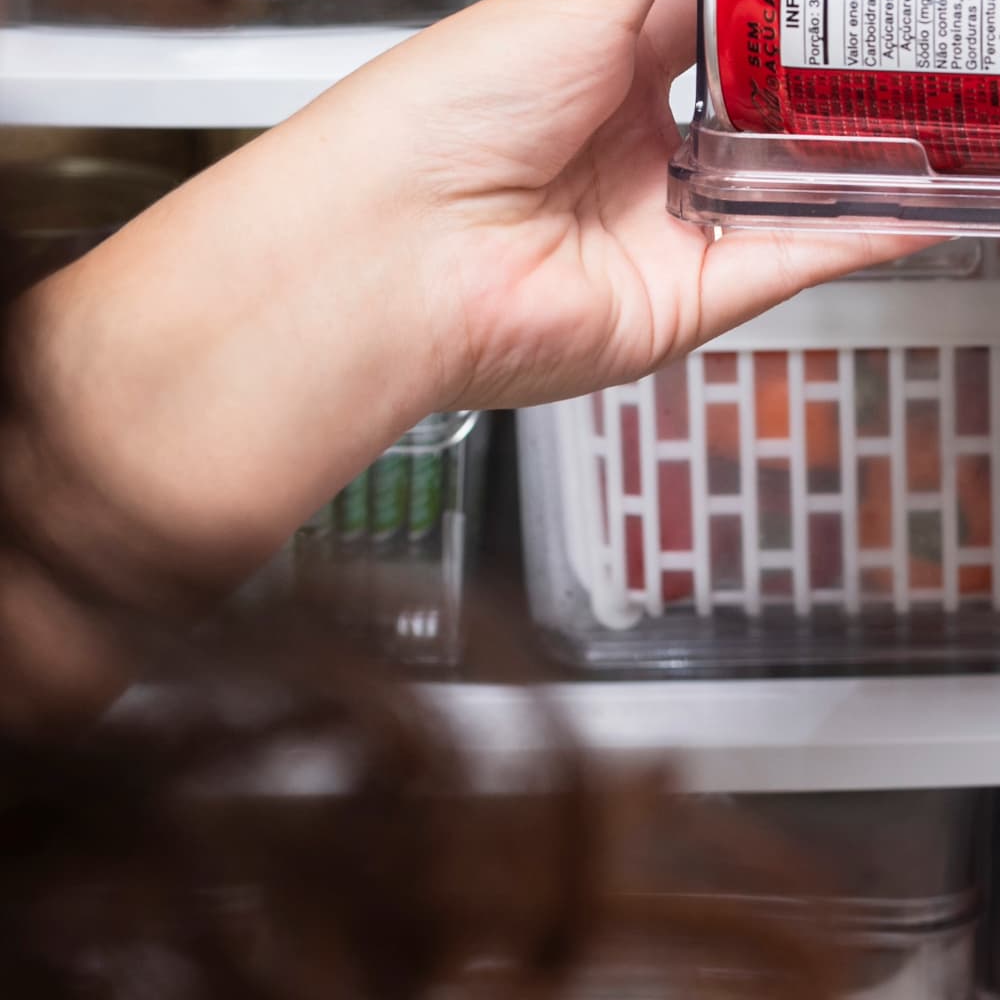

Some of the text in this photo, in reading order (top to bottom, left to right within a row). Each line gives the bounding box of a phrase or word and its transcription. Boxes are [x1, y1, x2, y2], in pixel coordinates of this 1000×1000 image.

[747, 22, 761, 68] SEM
[807, 12, 825, 67] Porção:
[846, 32, 859, 67] Valor
[915, 29, 930, 70] Sódio
[934, 41, 948, 70] Não
[965, 5, 978, 72] Gorduras
